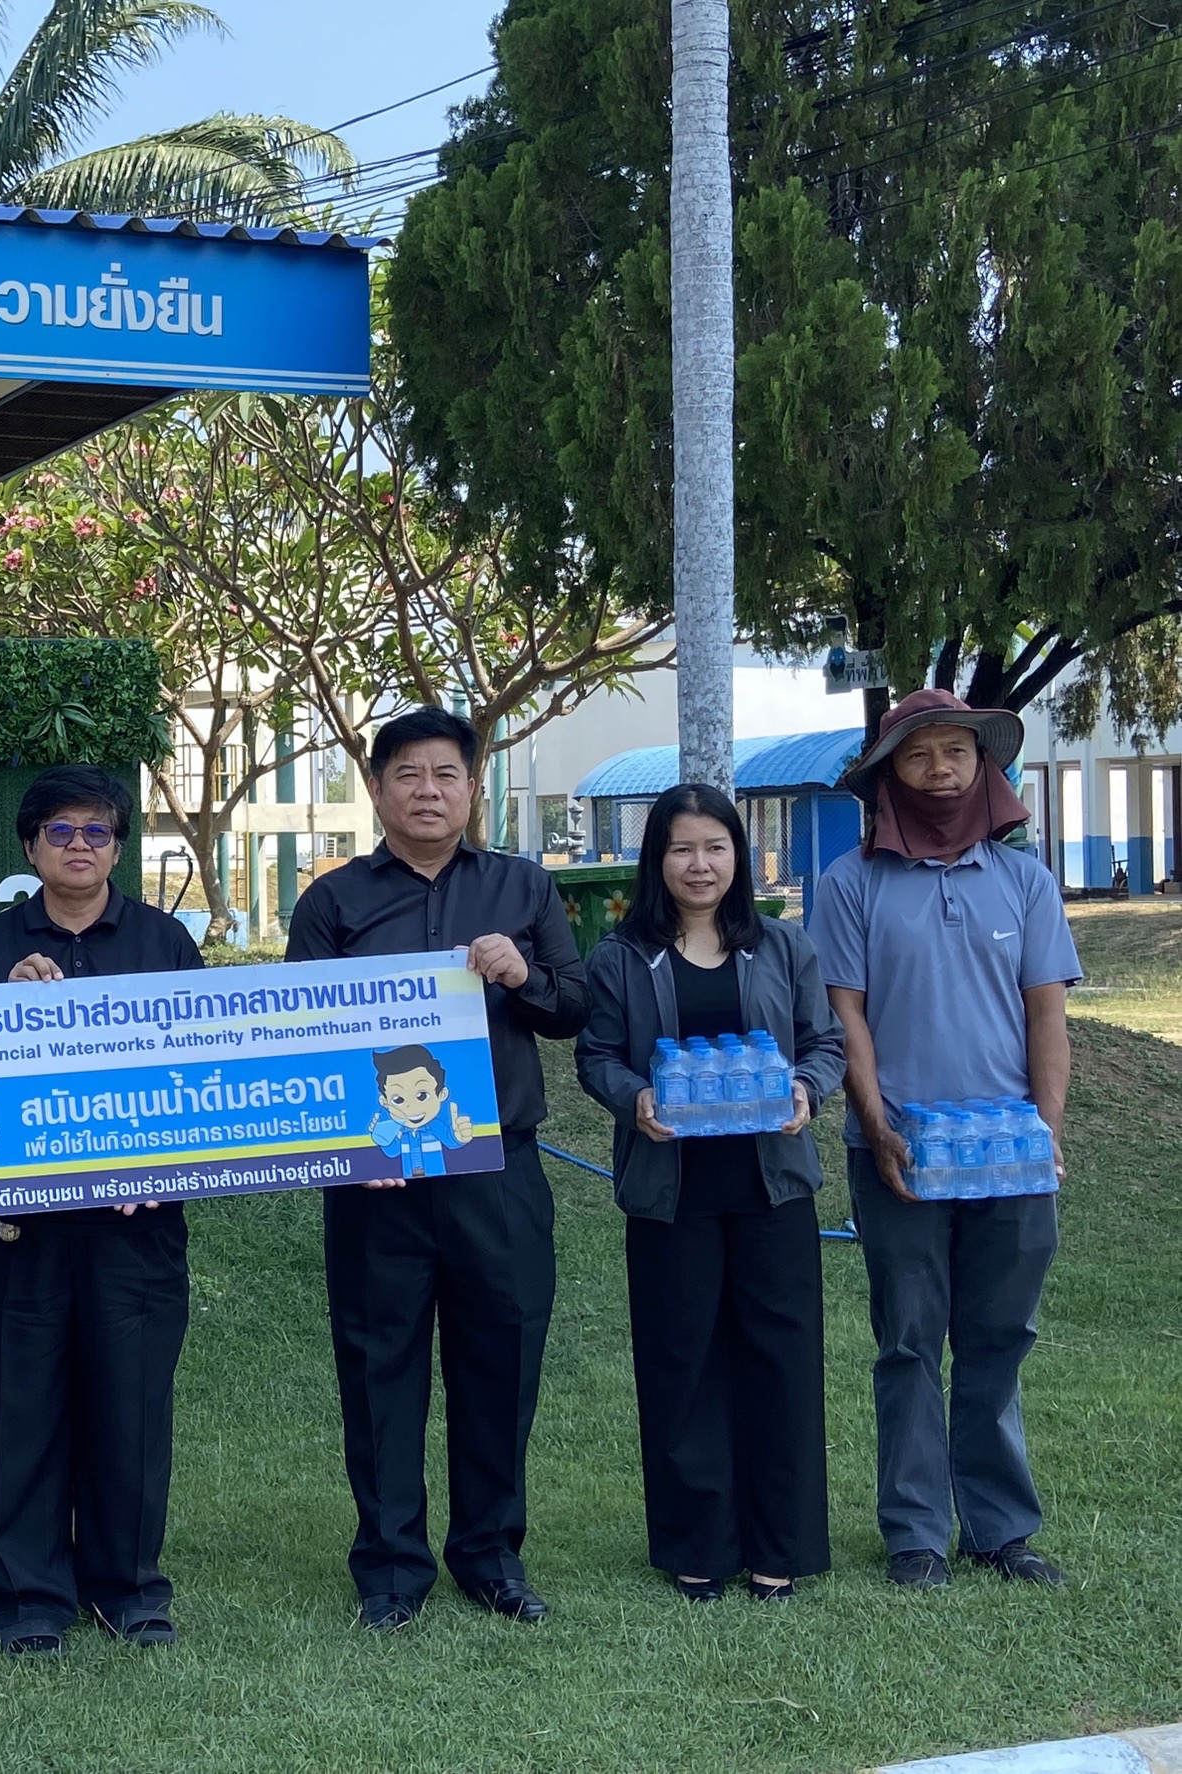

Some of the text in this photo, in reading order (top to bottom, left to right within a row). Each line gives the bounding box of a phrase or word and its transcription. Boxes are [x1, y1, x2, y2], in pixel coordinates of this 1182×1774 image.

[48, 1037, 155, 1058] Waterworks
[163, 1029, 244, 1050] Authority
[251, 1021, 372, 1043] Phanomthuan
[379, 1012, 441, 1031] Branch
[21, 1069, 345, 1128] สนับสนุนน้ำดื่มสะอาด
[24, 1110, 347, 1157] เพื่อใช้ในกิจกรรมสาธารณประโยชน์
[92, 1157, 351, 1199] พร้อมร่วมสร้างสังคมน่าอยู่ต่อไป
